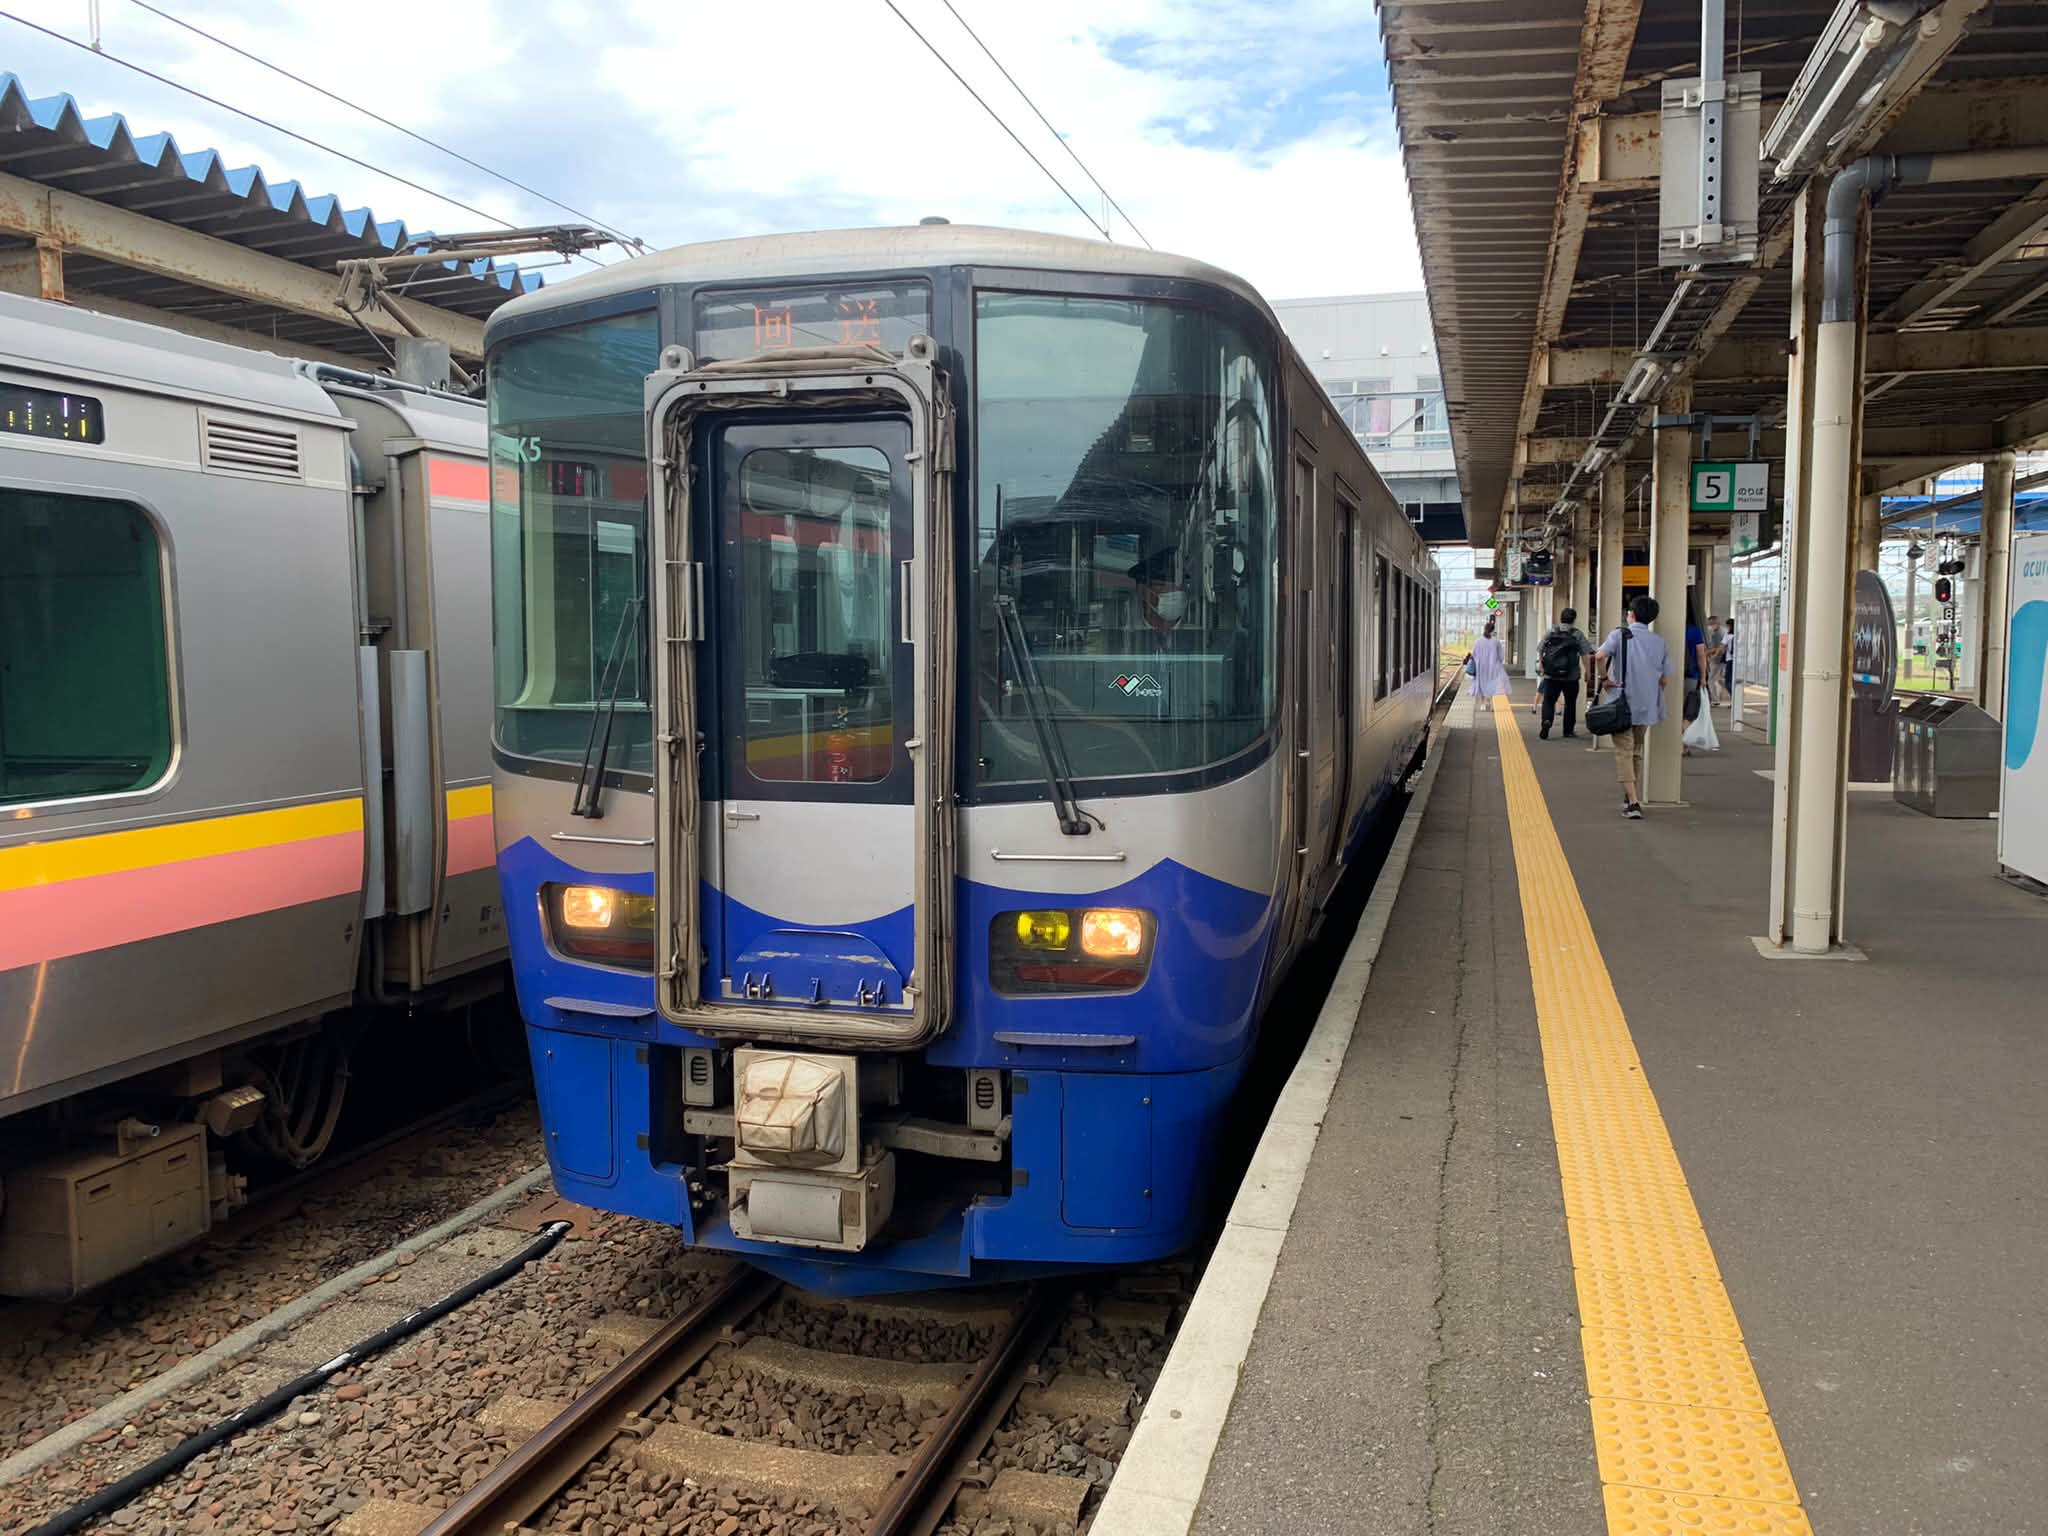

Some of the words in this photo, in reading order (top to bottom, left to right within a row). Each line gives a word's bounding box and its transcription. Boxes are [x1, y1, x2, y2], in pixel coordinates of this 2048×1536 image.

[515, 436, 542, 464] K5
[1705, 475, 1721, 499] 5
[1737, 487, 1765, 496] のりば
[2023, 560, 2048, 577] acur
